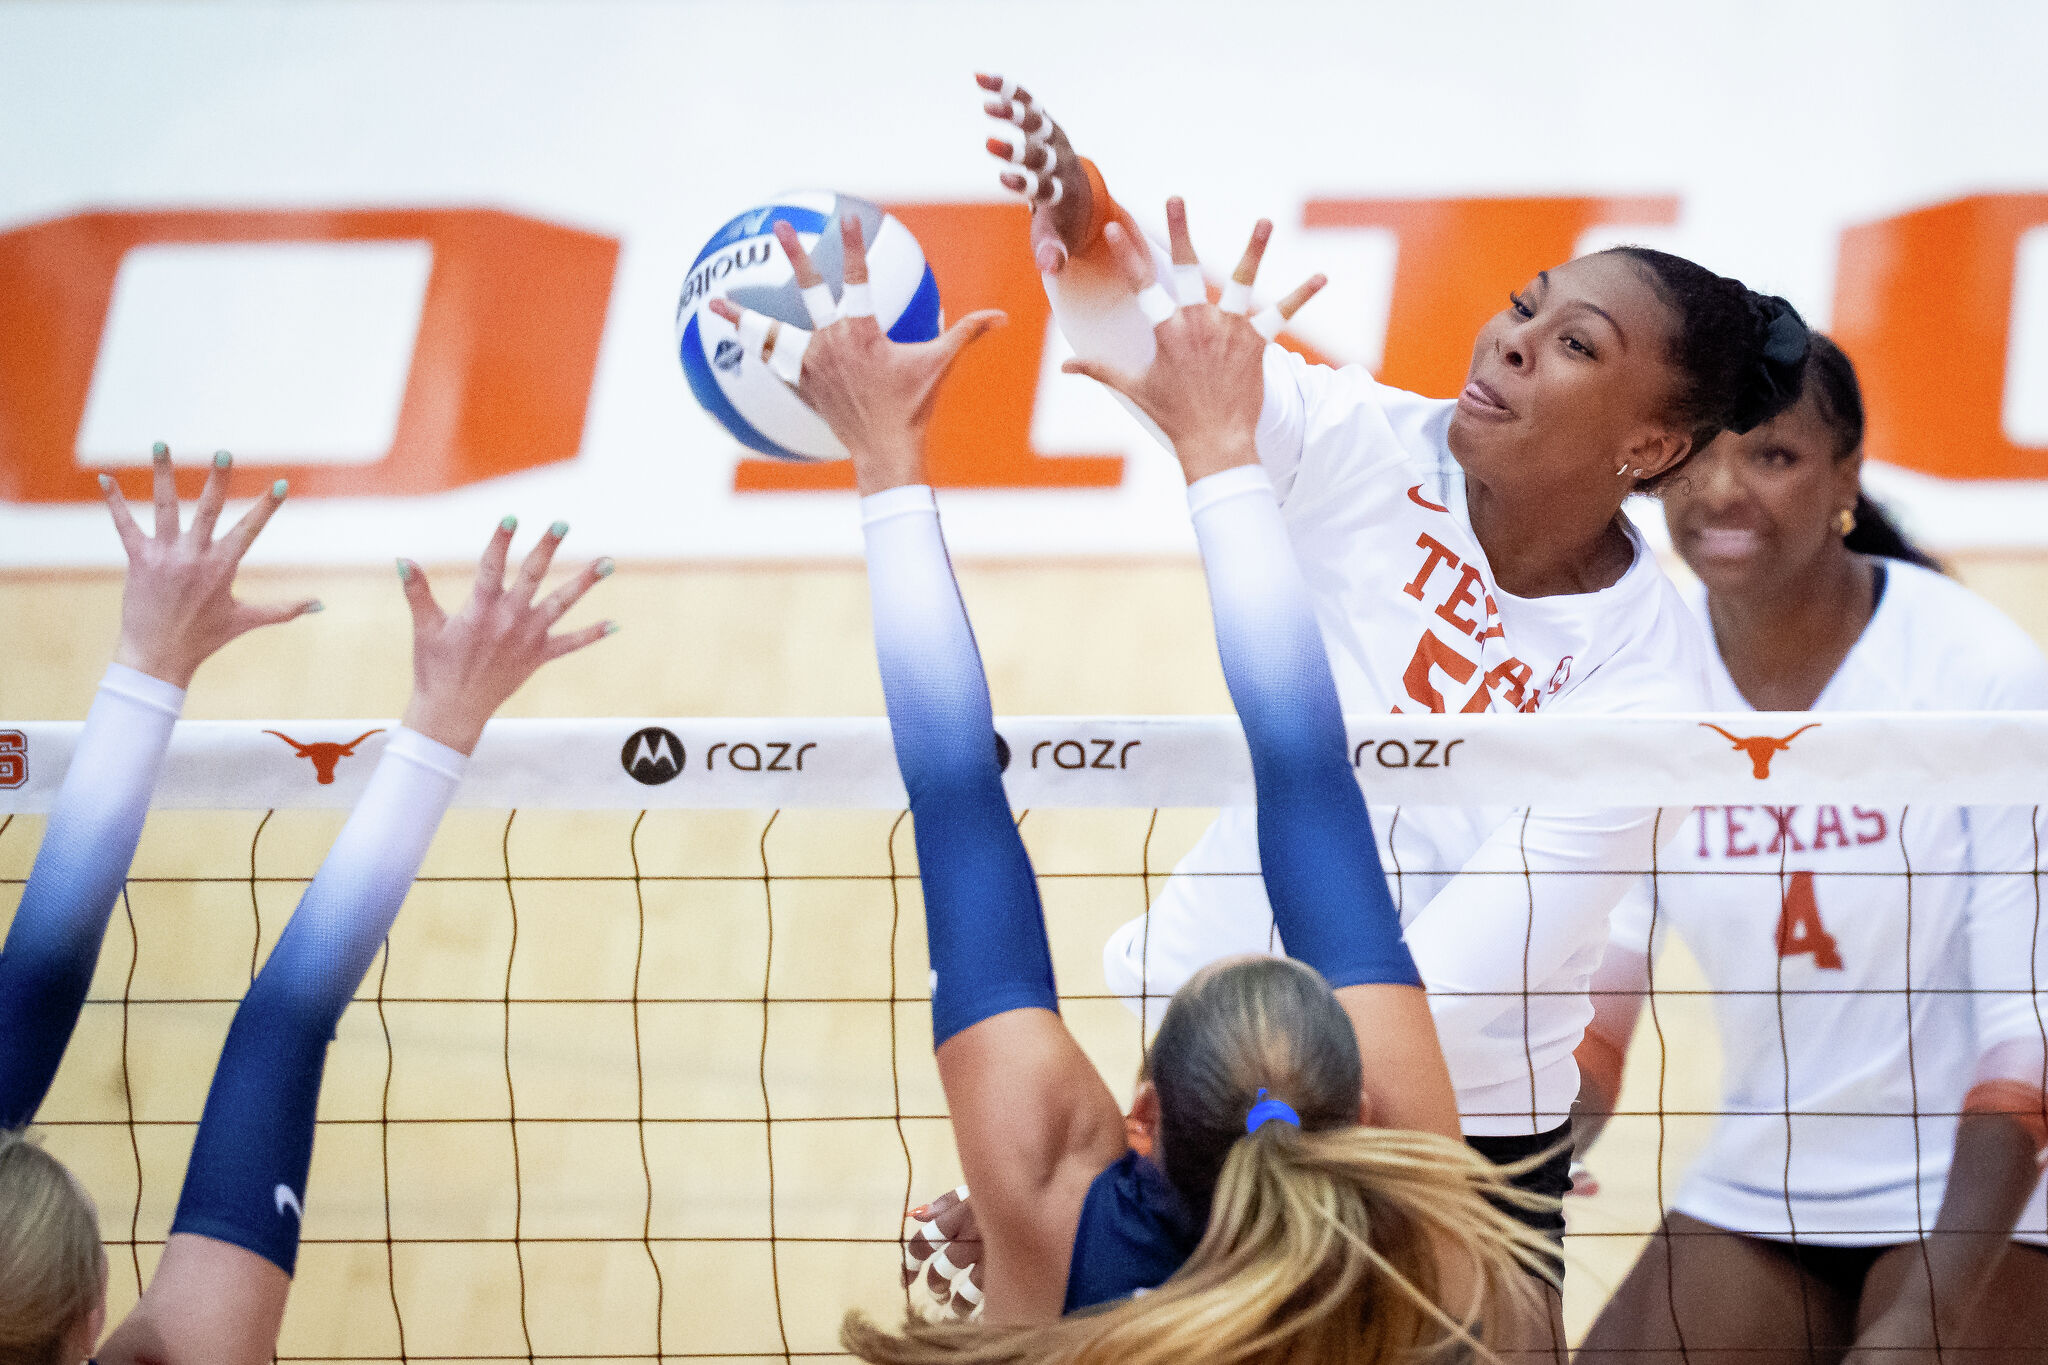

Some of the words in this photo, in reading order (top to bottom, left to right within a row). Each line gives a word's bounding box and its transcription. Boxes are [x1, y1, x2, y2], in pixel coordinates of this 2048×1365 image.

[707, 742, 818, 771] razr
[1031, 739, 1142, 769] razr
[1354, 738, 1466, 768] razr
[1691, 805, 1889, 857] TEXAS
[1774, 870, 1844, 970] 4
